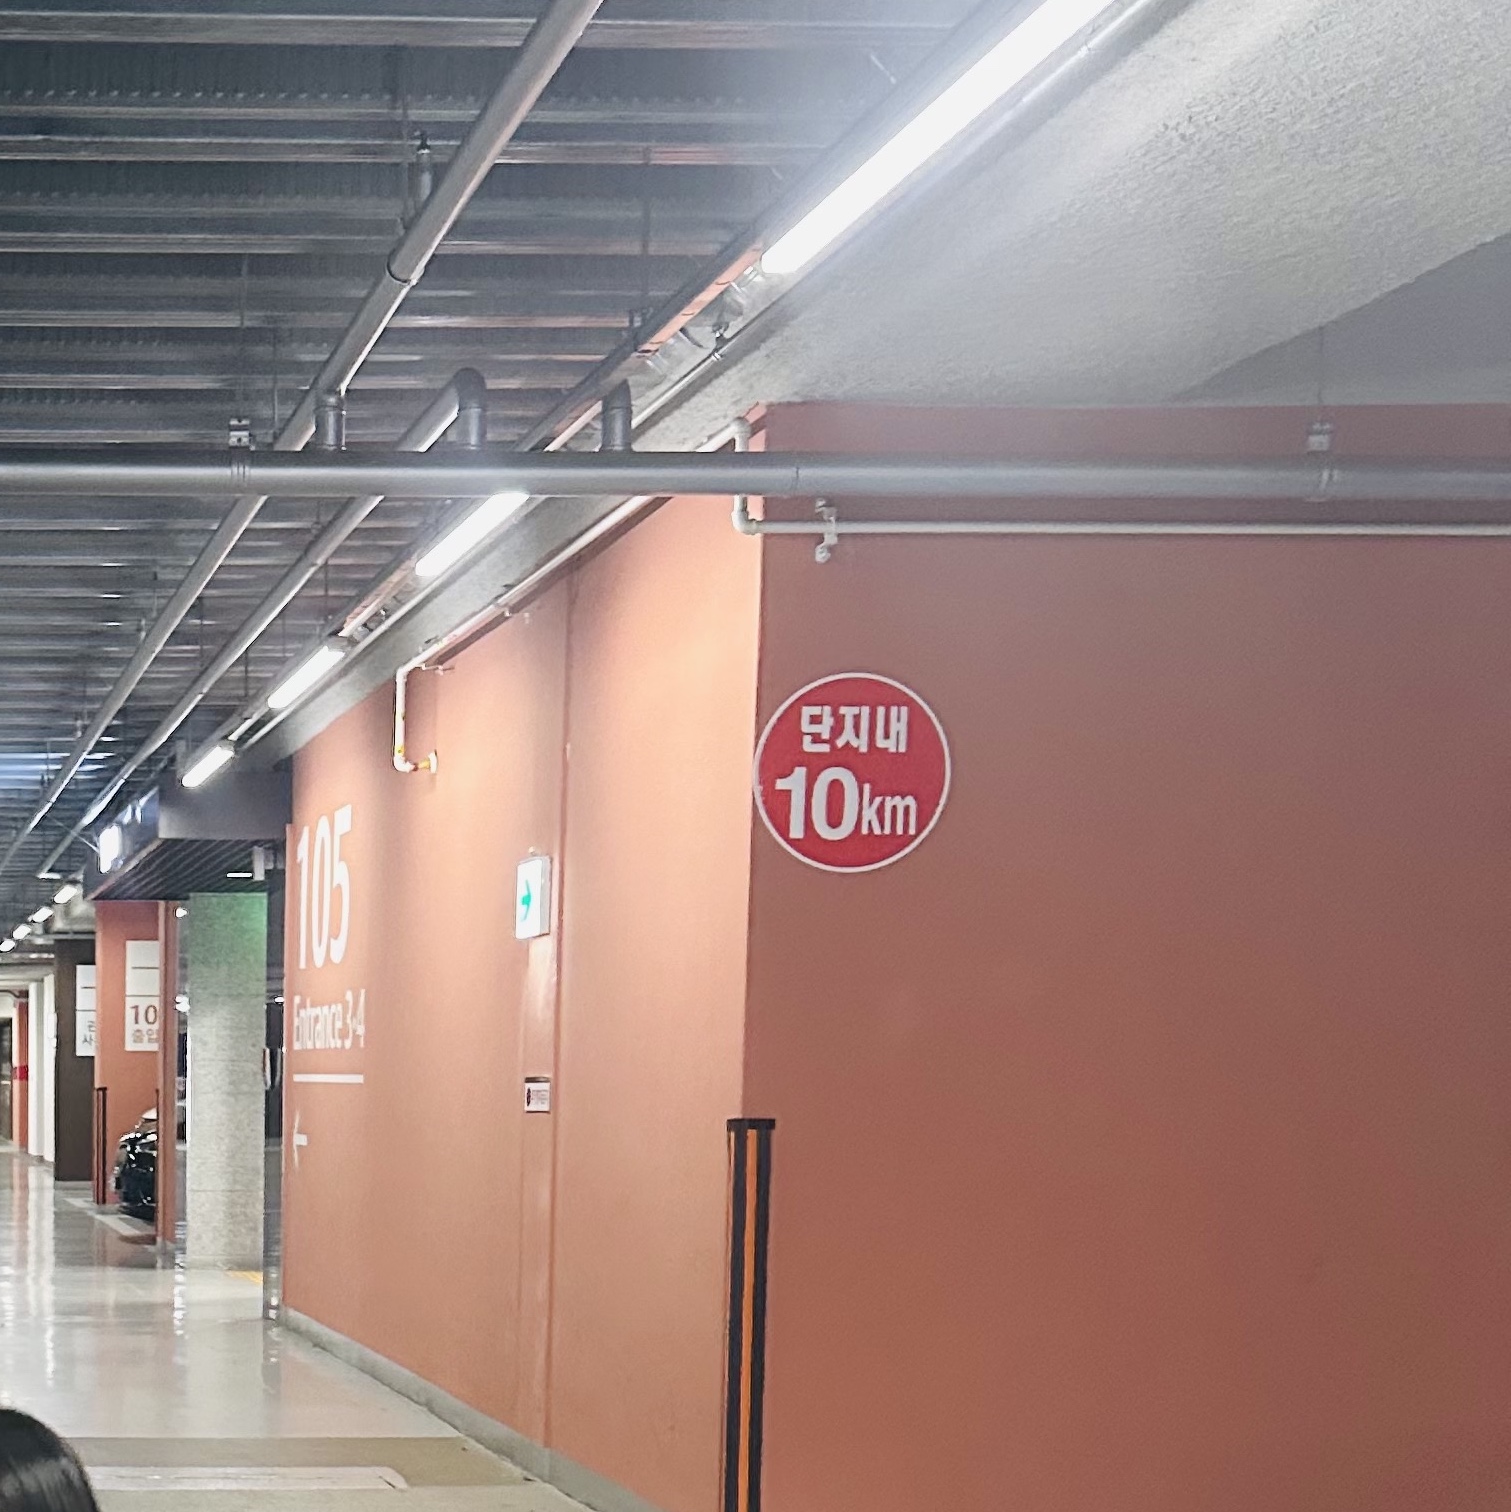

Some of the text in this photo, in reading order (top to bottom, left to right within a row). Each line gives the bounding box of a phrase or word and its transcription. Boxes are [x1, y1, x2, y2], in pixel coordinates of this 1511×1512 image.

[800, 705, 909, 753] 단지내
[296, 804, 352, 970] 105
[130, 1004, 158, 1025] 10
